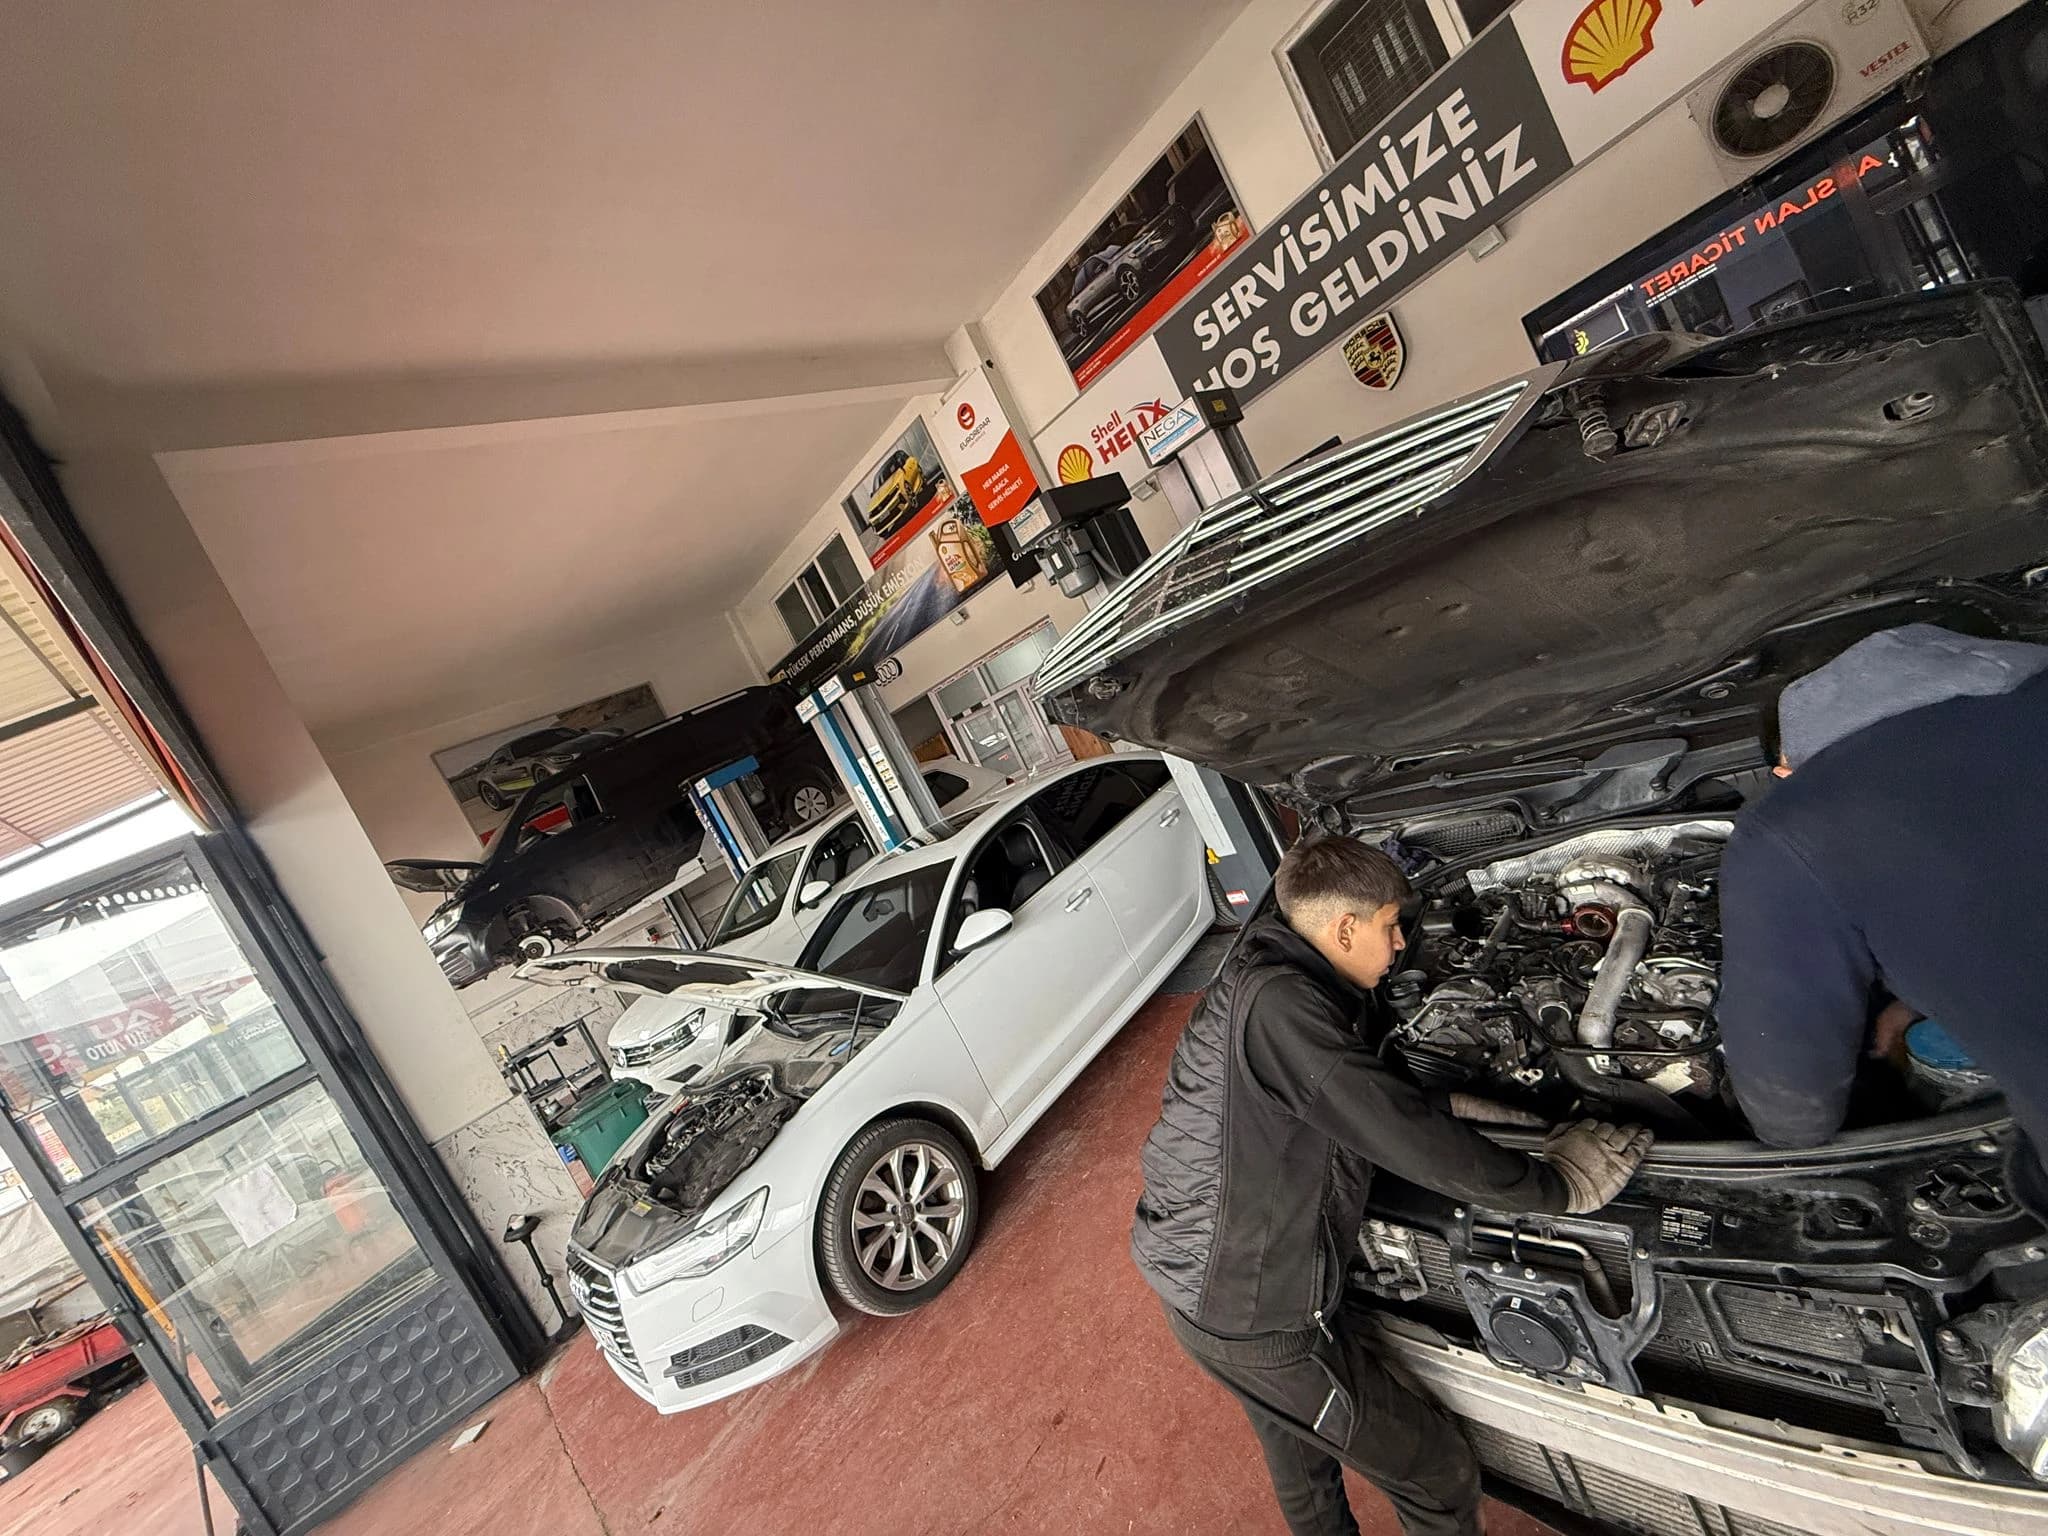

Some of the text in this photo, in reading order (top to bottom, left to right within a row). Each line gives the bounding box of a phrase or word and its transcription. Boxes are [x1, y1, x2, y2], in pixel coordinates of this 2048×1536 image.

[1859, 41, 1911, 77] VESTEL
[1193, 88, 1479, 352] SERVİSİMİZE
[1290, 124, 1538, 338] GELDİNİZ
[1342, 317, 1387, 354] PORSCHE
[959, 416, 991, 451] EUROREPAR
[1090, 409, 1122, 444] Shell
[1096, 397, 1171, 465] HELIX
[1143, 408, 1195, 446] NEGA
[787, 654, 812, 679] YÜKSEK
[809, 614, 858, 660] PERFORMANS,
[854, 590, 885, 621] DÜŞÜK
[881, 557, 925, 597] EMİSYON
